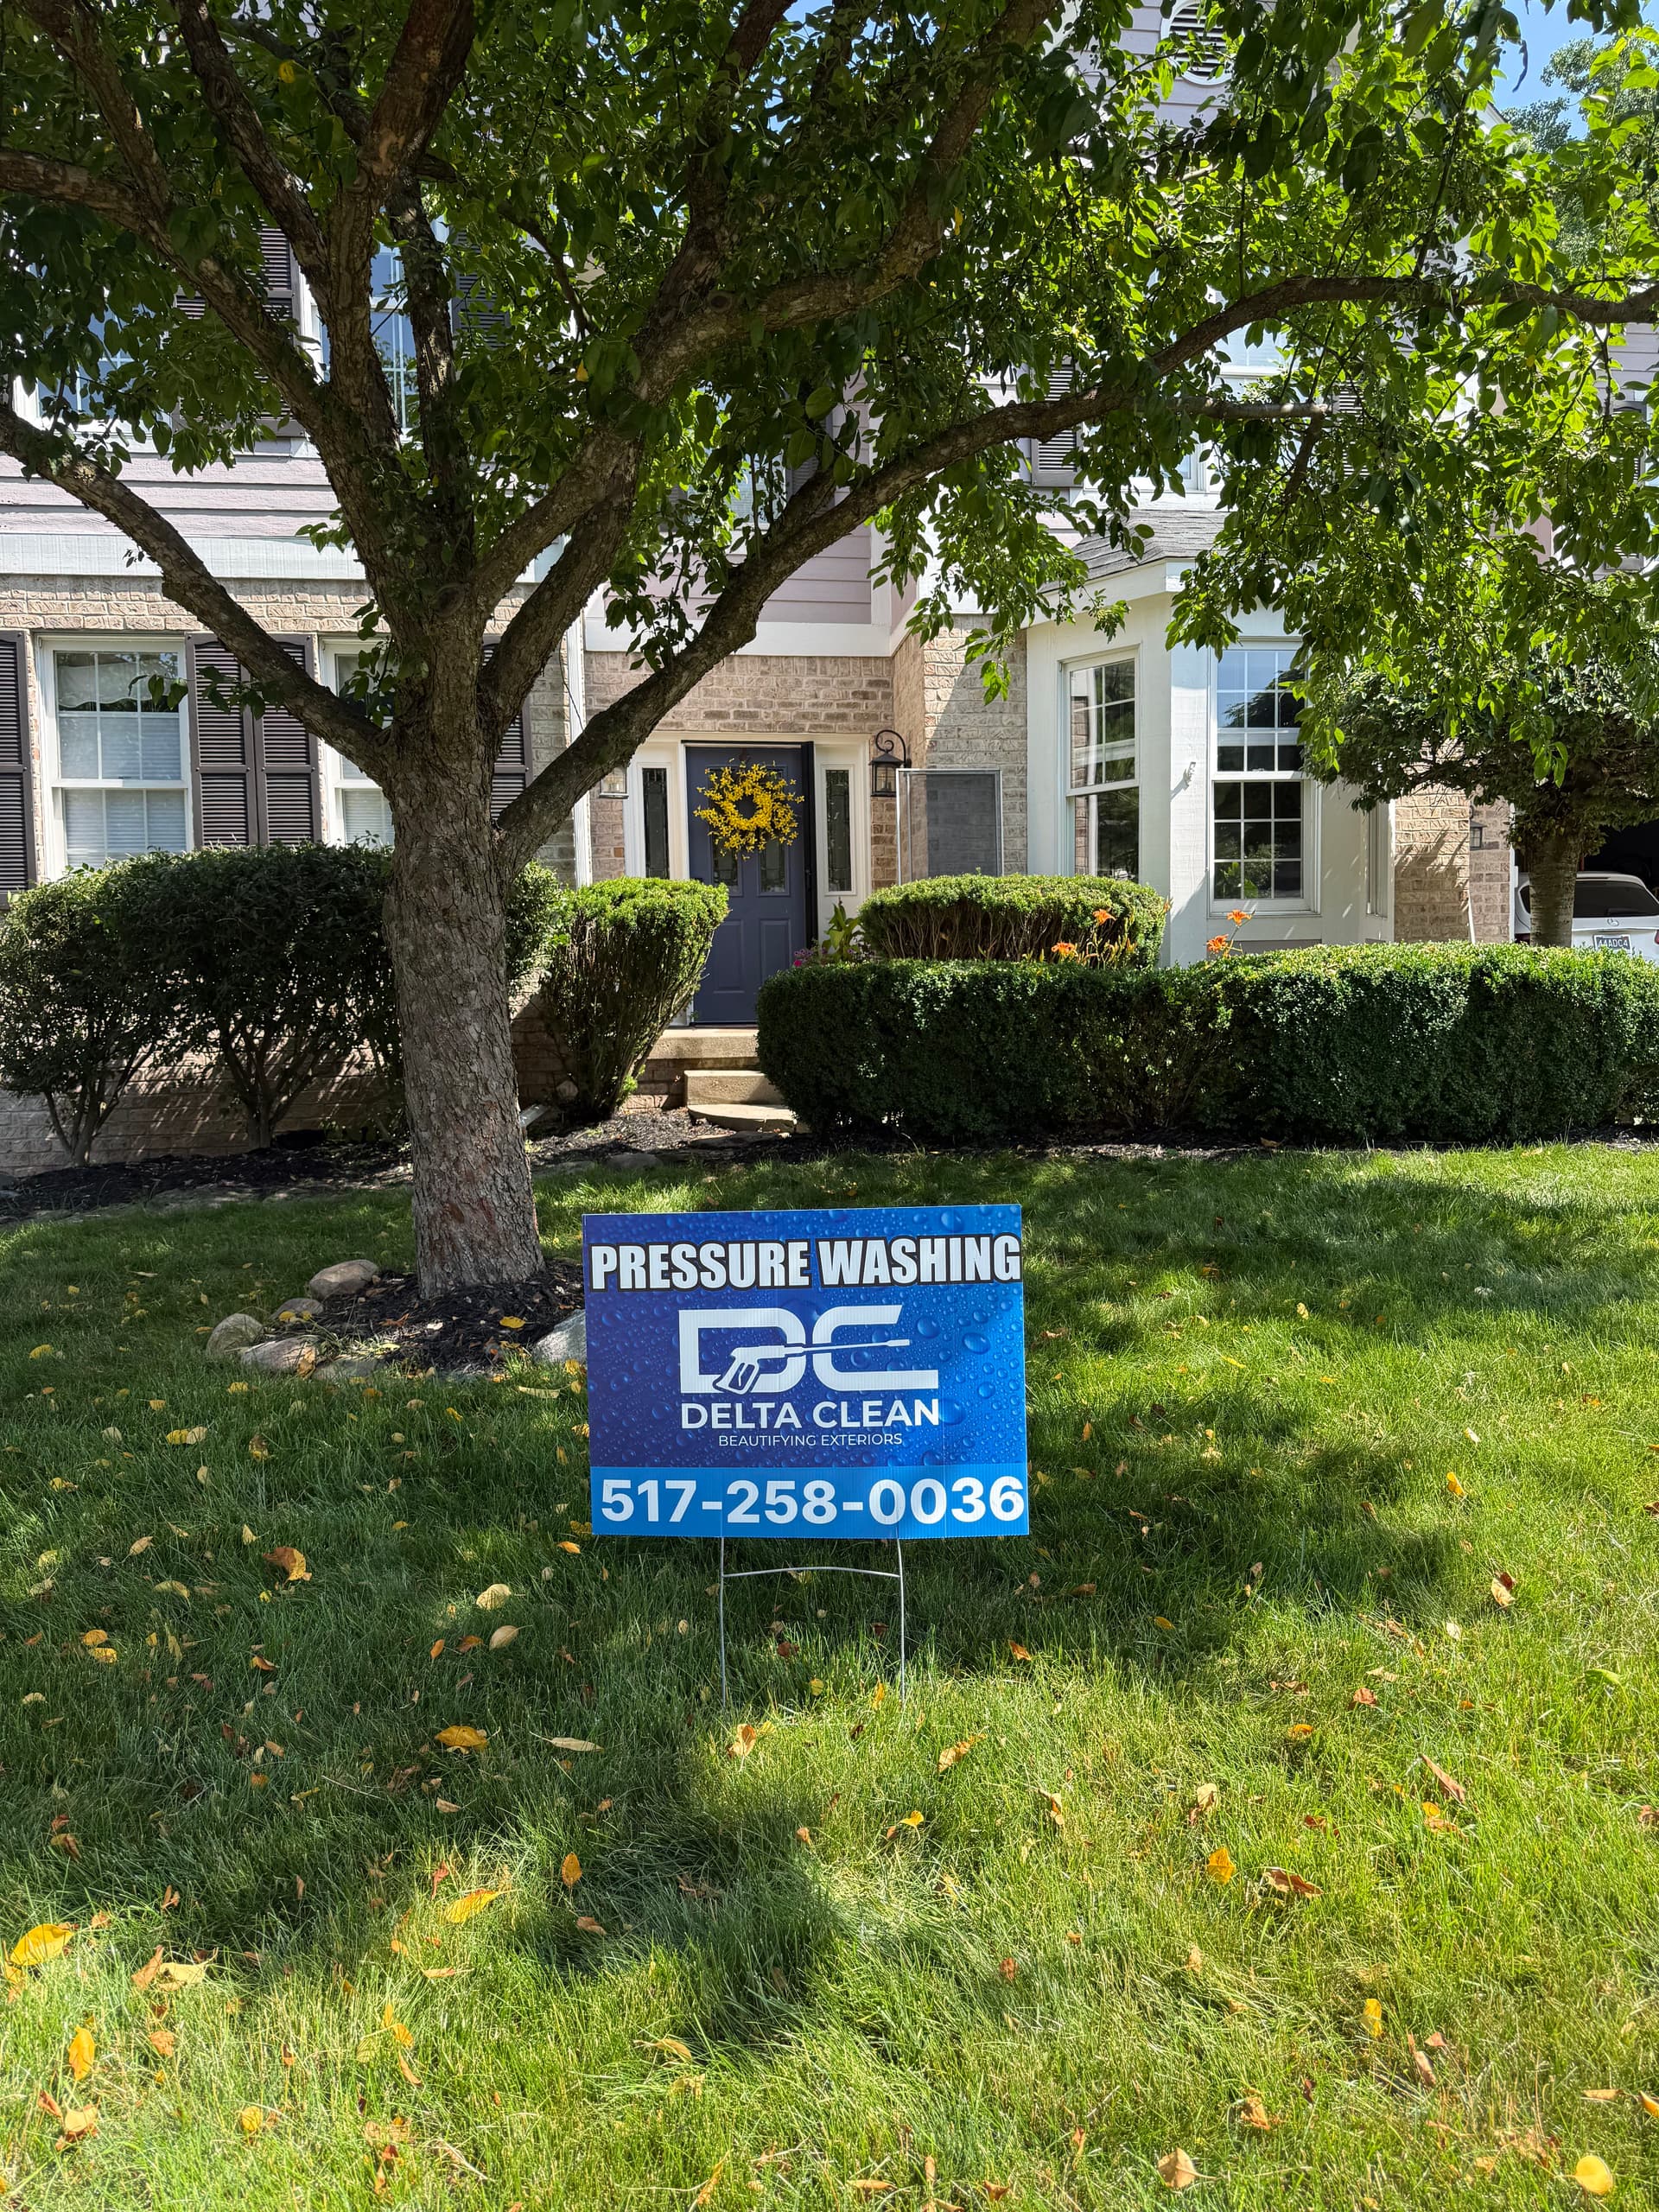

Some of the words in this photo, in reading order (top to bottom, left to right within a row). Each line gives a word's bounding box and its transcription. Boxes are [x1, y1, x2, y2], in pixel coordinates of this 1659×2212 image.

[590, 1241, 810, 1290] PRESSURE
[817, 1234, 1022, 1286] WASHING
[678, 1305, 938, 1394] DC
[681, 1402, 802, 1429] DELTA
[812, 1399, 939, 1427] CLEAN
[718, 1434, 817, 1447] BEAUTIFYING
[821, 1433, 903, 1446] EXTERIORS
[601, 1476, 1025, 1525] 517-258-0036
